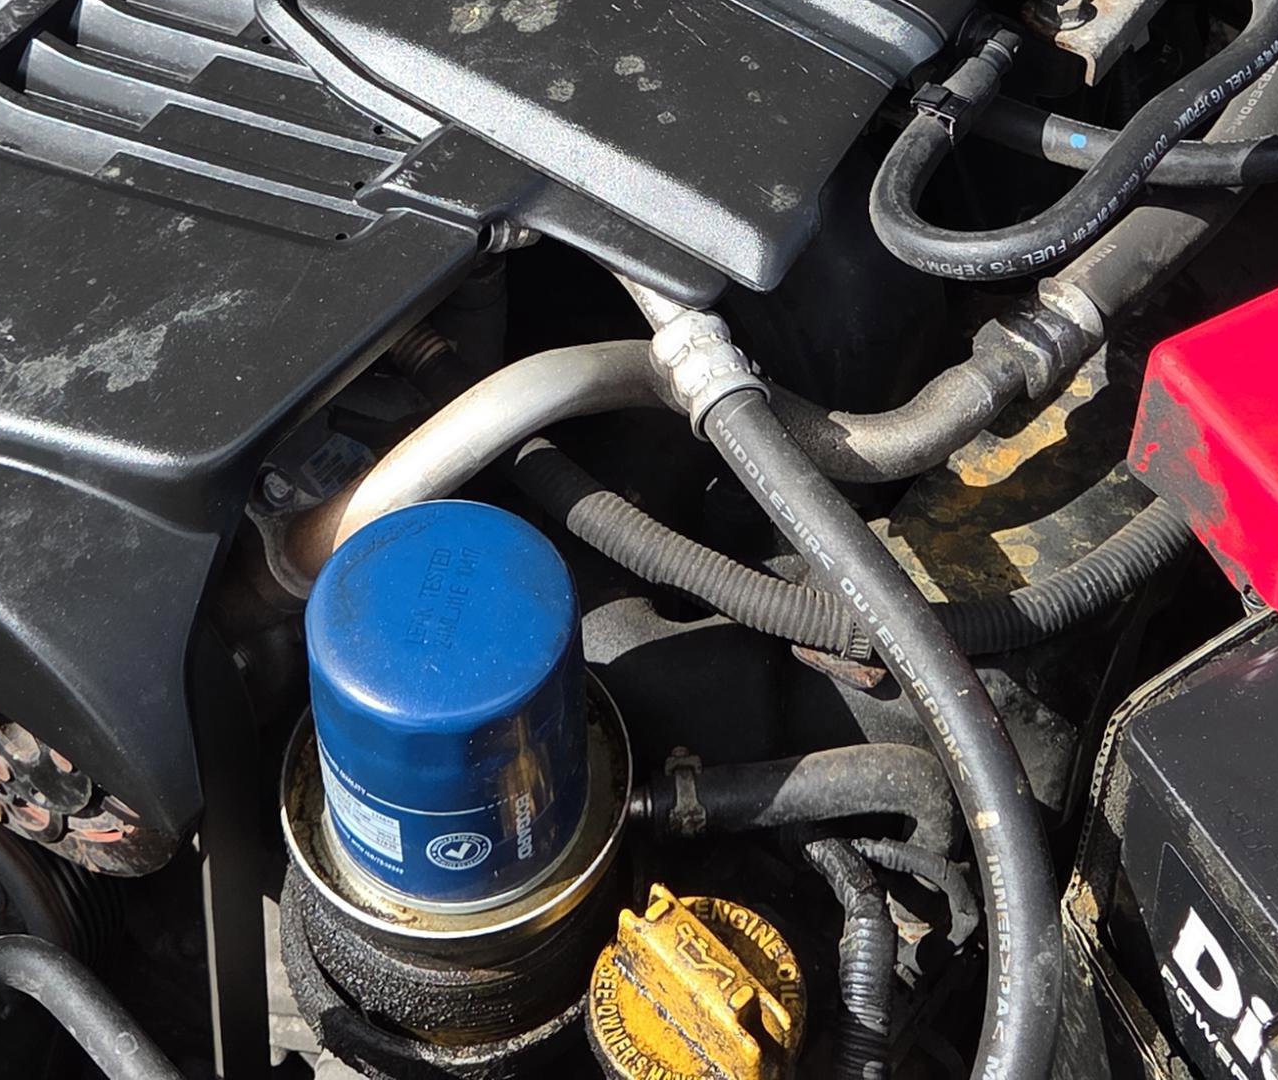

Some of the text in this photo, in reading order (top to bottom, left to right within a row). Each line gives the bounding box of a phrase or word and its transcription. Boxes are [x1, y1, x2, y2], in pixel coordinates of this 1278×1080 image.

[1223, 63, 1254, 90] FUEL
[1020, 237, 1067, 265] FUEL
[416, 544, 452, 602] TESTED
[695, 897, 801, 1003] ENGINE OIL
[595, 964, 620, 1001] SEE
